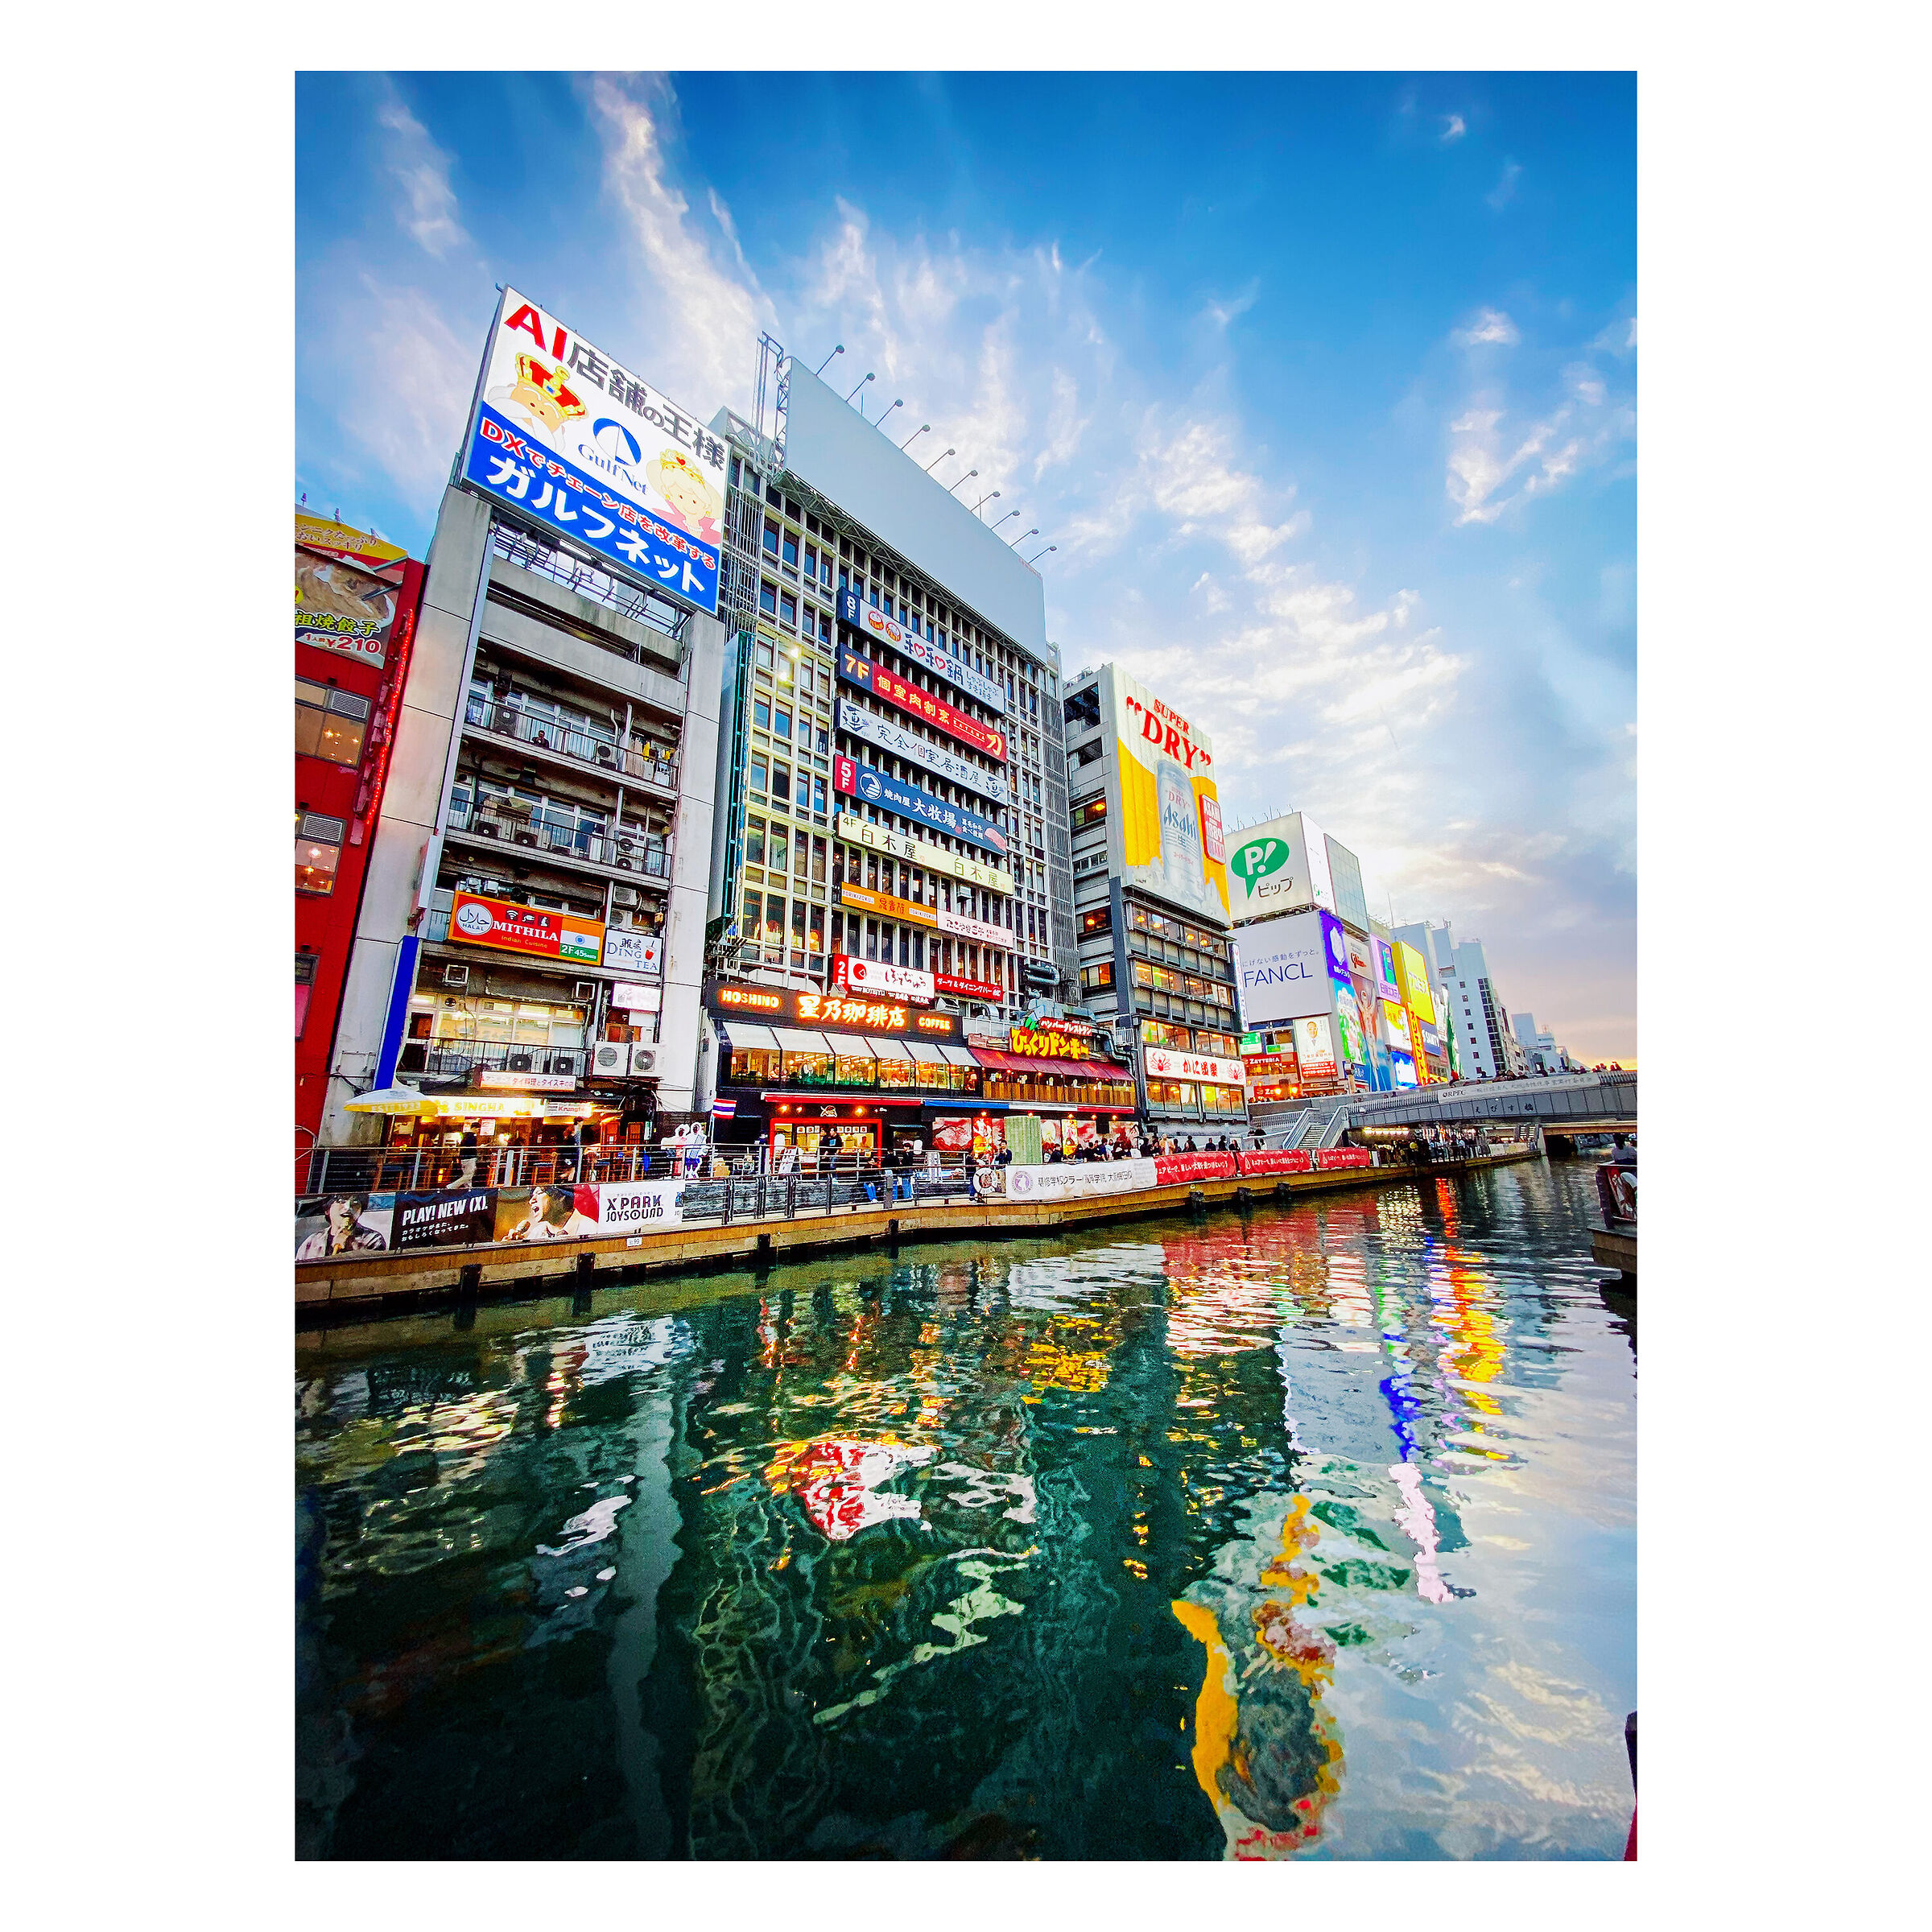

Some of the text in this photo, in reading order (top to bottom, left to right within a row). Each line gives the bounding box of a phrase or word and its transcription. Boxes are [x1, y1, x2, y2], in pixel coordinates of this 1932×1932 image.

[504, 303, 725, 472] AI店舗の王様
[481, 417, 716, 571] DXでチェーン店を改革する
[487, 455, 705, 593] ガルフネット
[844, 654, 870, 679] 7F
[1154, 699, 1190, 735] SUPER
[840, 762, 852, 789] 5F
[843, 816, 857, 828] 4F
[912, 797, 957, 829] 大牧場
[1163, 802, 1197, 841] Asahi
[861, 824, 918, 861] 白木屋
[954, 857, 1000, 889] 白木屋
[1257, 877, 1294, 898] ピップ
[462, 923, 485, 931] HALAL
[492, 920, 559, 942] MITHILA
[501, 935, 522, 943] Indian
[561, 944, 575, 955] 2F
[606, 941, 642, 959] DING
[635, 960, 658, 971] TEA
[1244, 962, 1313, 988] FANCL
[722, 989, 780, 1008] HOSHINO
[799, 994, 906, 1030] 星乃珈琲店
[918, 1016, 951, 1030] COFFEE
[1041, 1018, 1092, 1035] ハンバーグレストラン
[454, 1101, 506, 1113] SINGHA
[402, 1204, 436, 1226] PLAY!
[438, 1199, 467, 1220] NEW
[606, 1195, 662, 1211] X PARK
[606, 1207, 663, 1222] JOYSOUND
